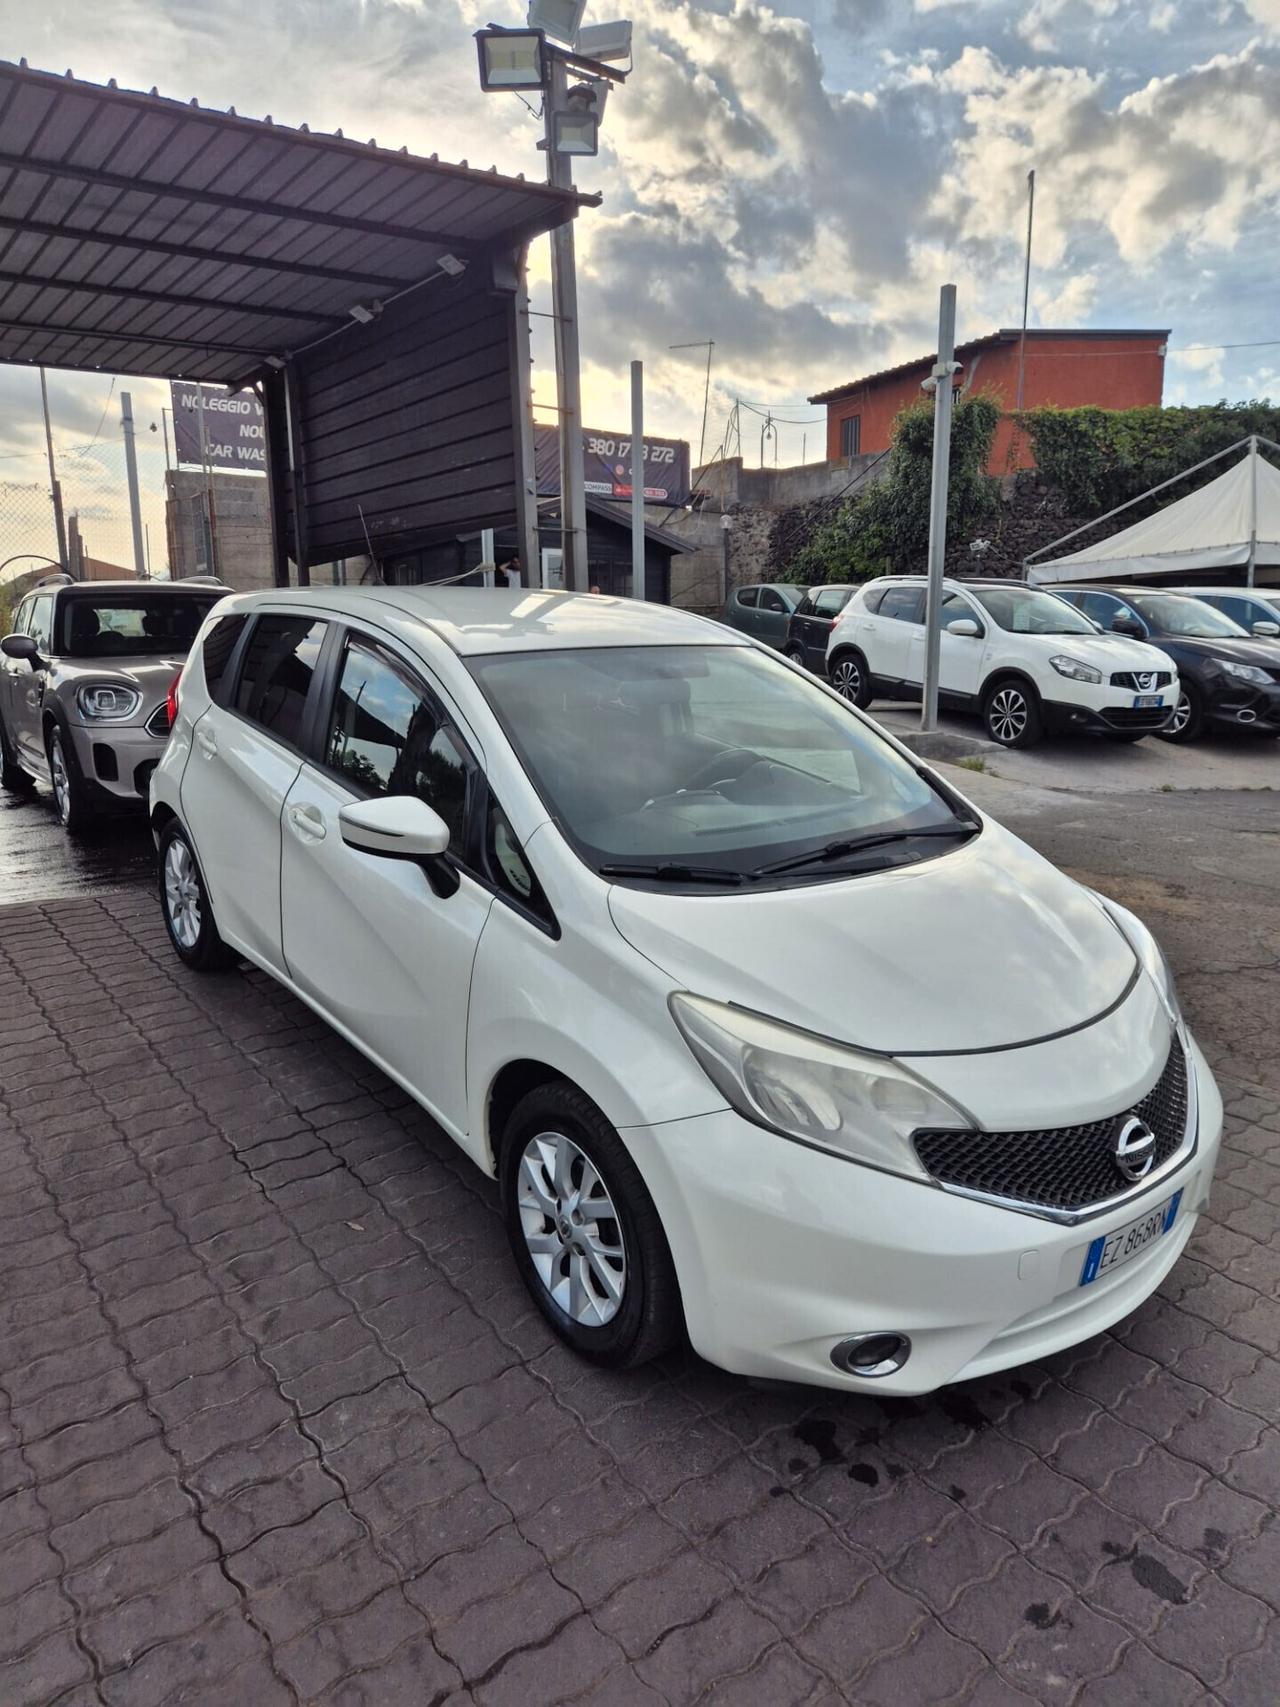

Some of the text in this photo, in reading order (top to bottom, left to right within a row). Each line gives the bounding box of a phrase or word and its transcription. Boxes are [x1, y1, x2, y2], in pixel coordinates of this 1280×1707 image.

[181, 394, 251, 415] NOLEGGIO
[205, 444, 233, 458] CAR
[588, 438, 615, 456] 380
[651, 446, 675, 463] 272
[1100, 1235, 1124, 1269] EZ
